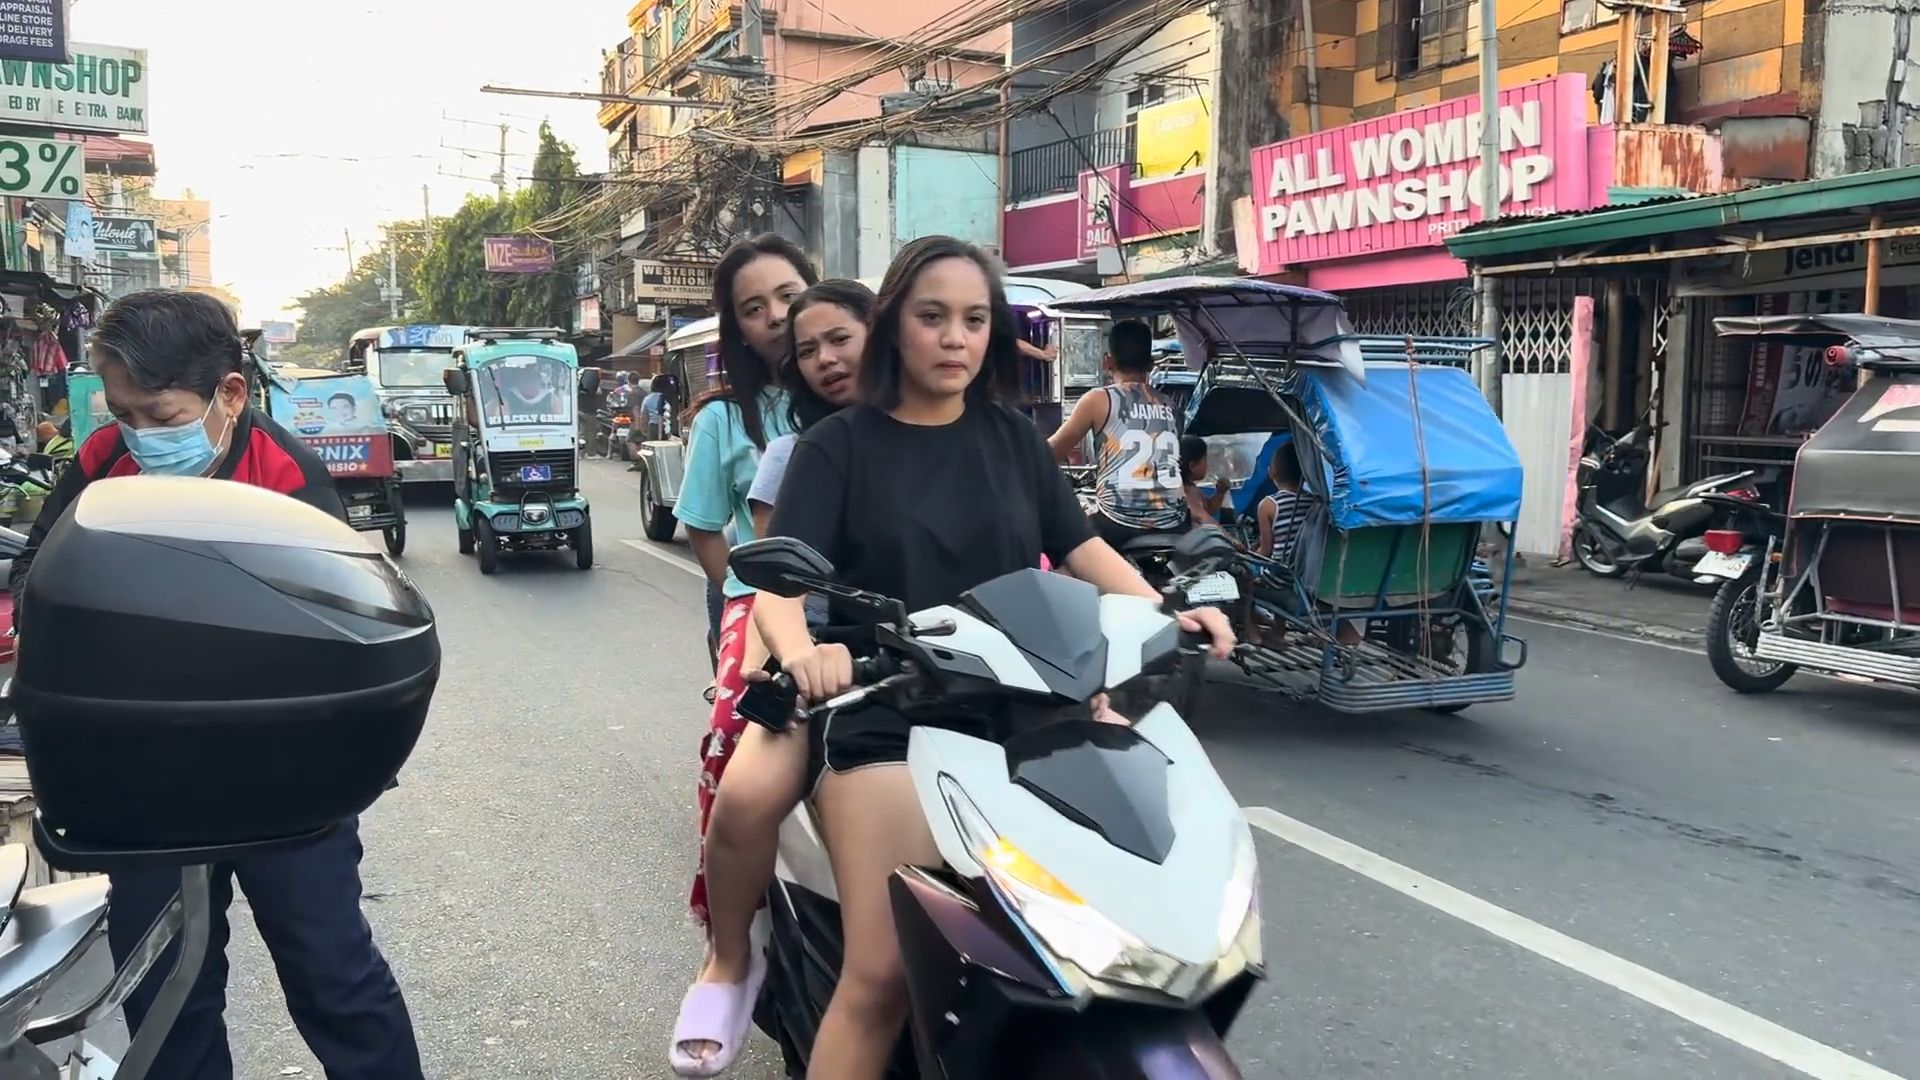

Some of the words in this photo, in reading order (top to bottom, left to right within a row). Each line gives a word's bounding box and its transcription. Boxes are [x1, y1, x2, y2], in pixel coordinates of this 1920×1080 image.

[0, 2, 53, 15] APPRAISAL
[8, 24, 53, 37] DELIVERY
[22, 15, 53, 26] STORE
[30, 37, 54, 48] FEES
[0, 54, 142, 98] WNSHOP
[26, 97, 41, 112] BY
[116, 106, 143, 122] BANK
[0, 141, 79, 195] 3%
[1269, 148, 1346, 198] ALL
[1262, 154, 1553, 242] PAWNSHOP
[488, 243, 512, 267] MZE
[643, 266, 706, 277] WESTERN
[662, 276, 706, 286] UNION
[1130, 402, 1174, 421] JAMES
[1117, 429, 1183, 489] 23
